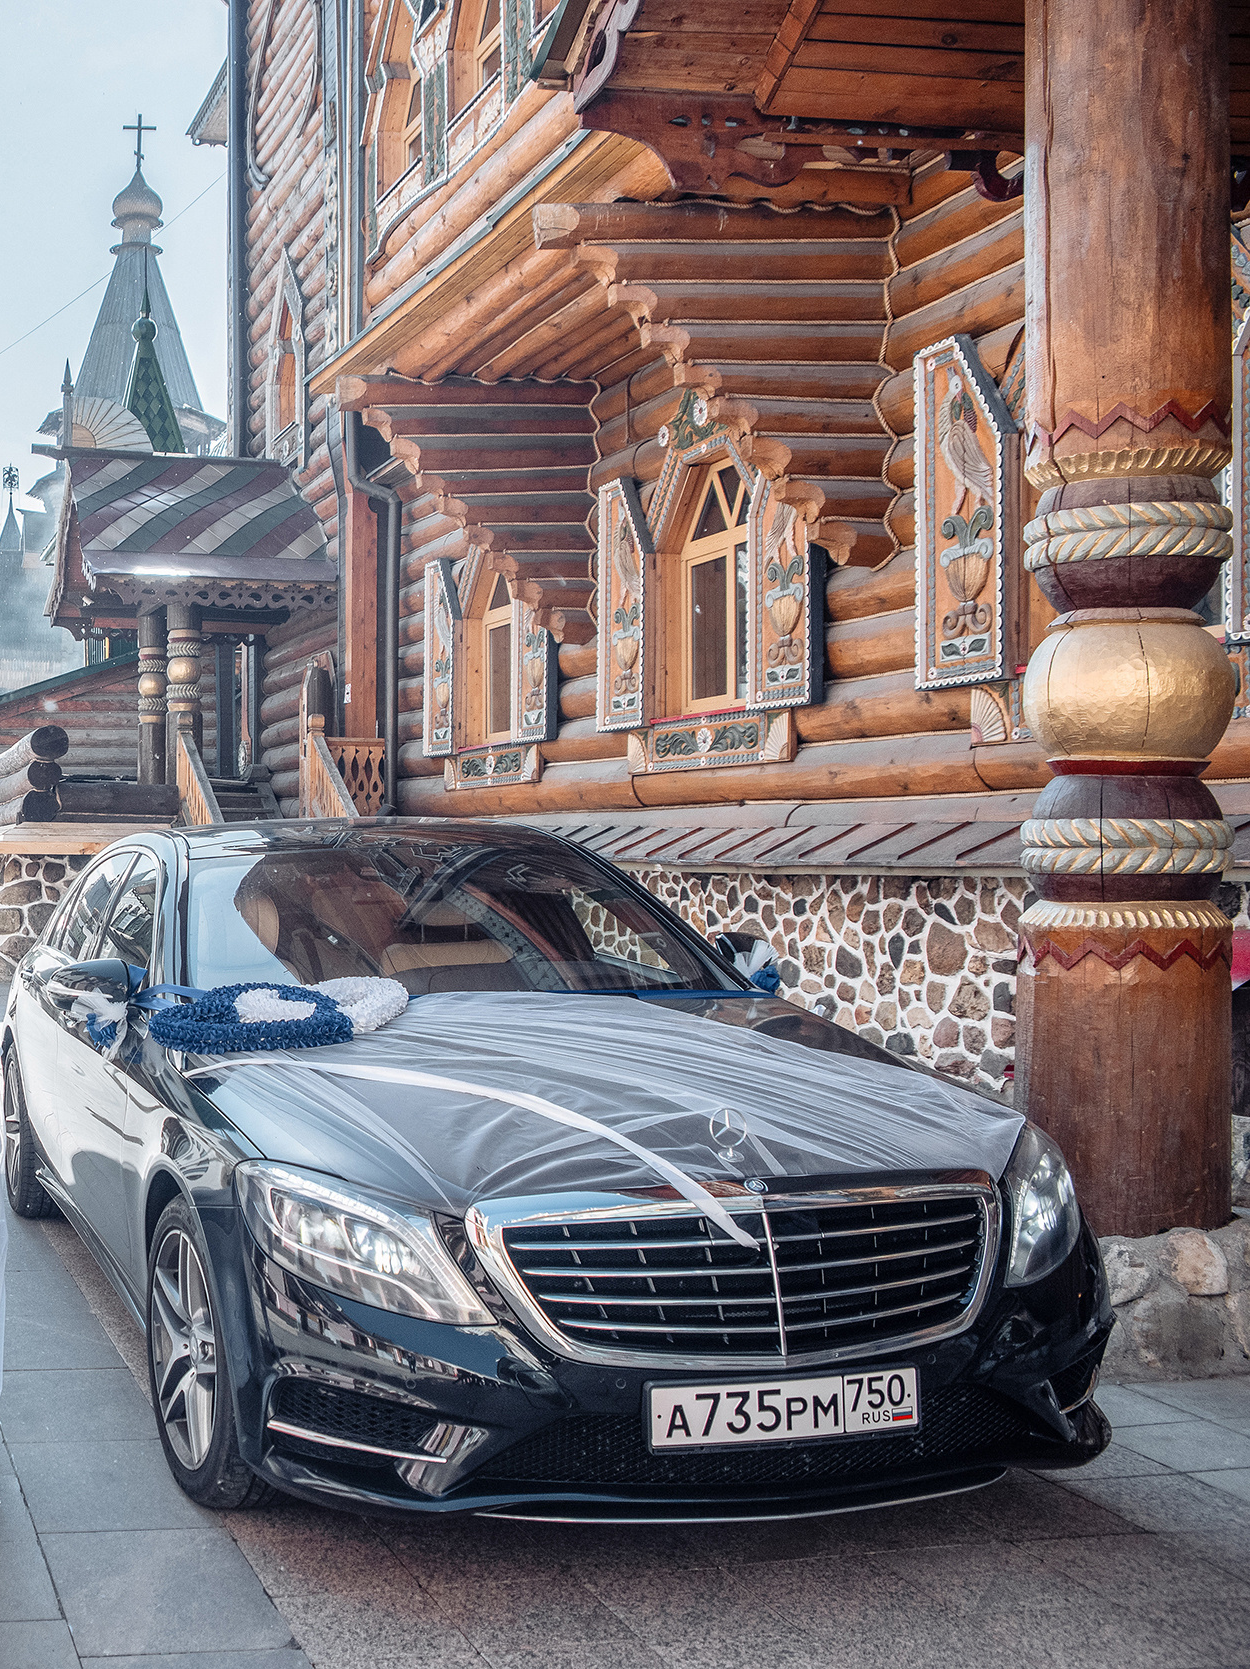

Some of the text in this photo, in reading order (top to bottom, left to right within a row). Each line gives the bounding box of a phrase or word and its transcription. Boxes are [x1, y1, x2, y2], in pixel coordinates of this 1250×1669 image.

[666, 1374, 905, 1438] A735PM 750
[862, 1410, 891, 1425] RUS
